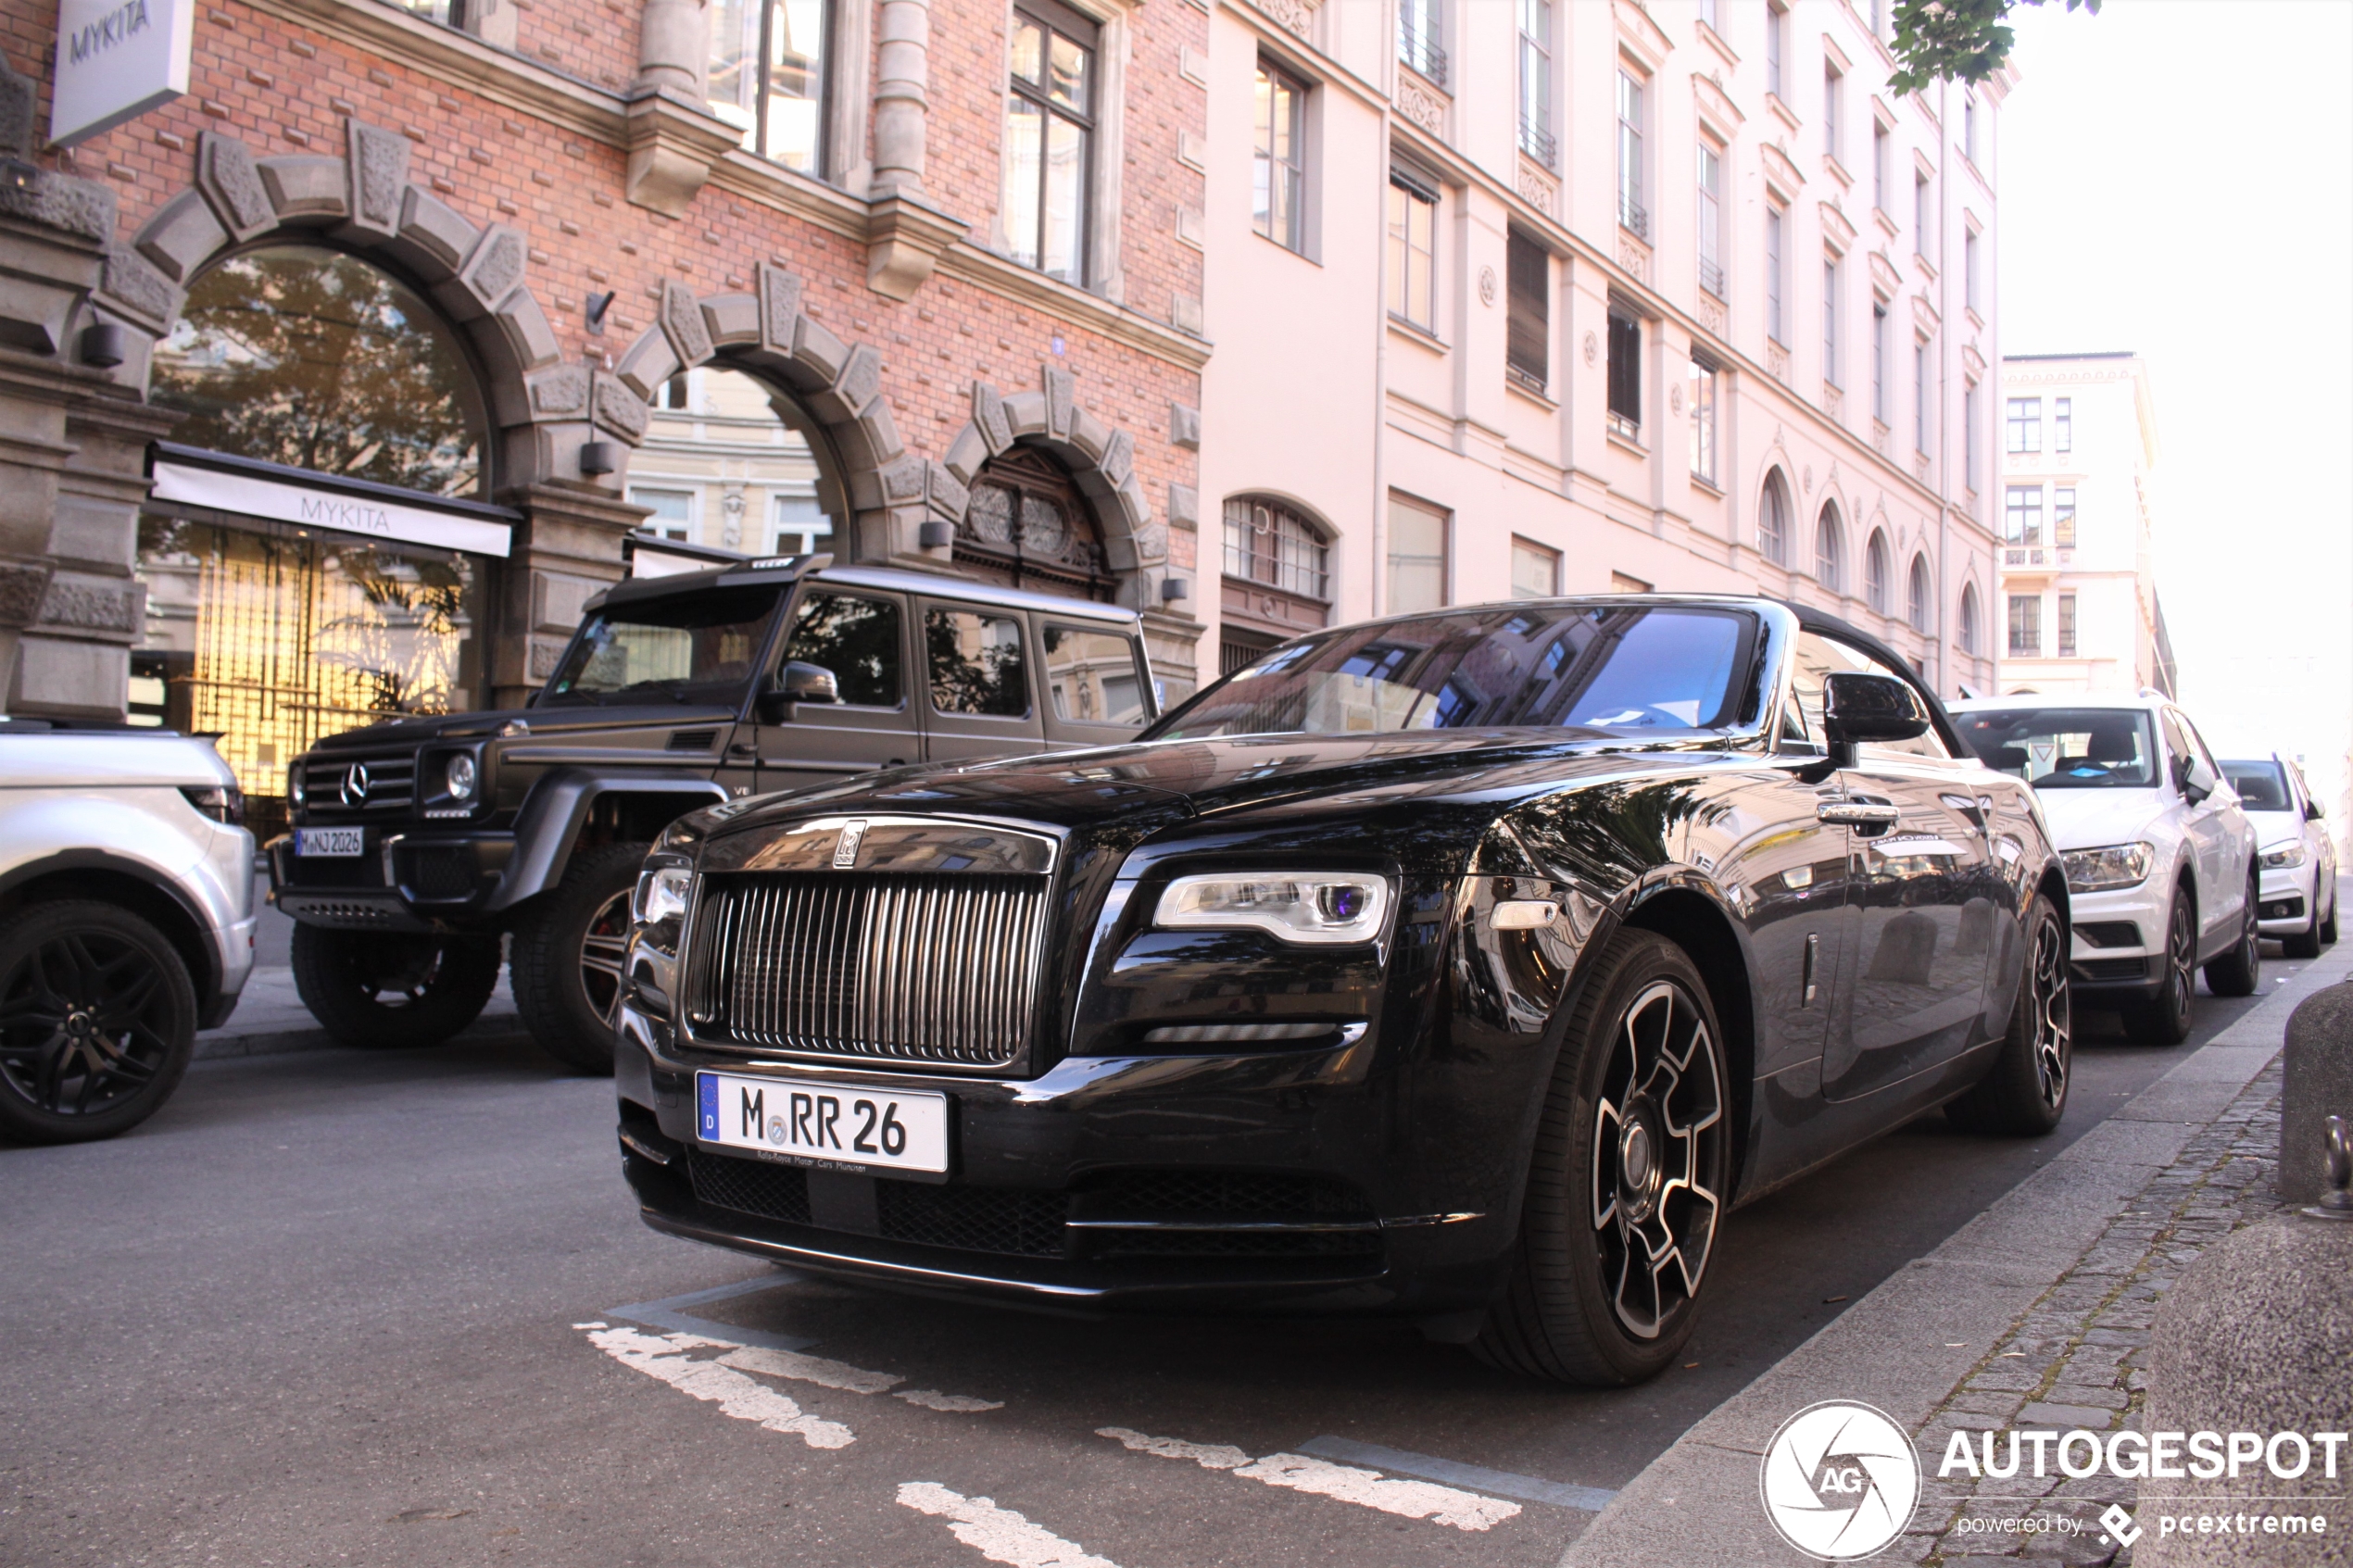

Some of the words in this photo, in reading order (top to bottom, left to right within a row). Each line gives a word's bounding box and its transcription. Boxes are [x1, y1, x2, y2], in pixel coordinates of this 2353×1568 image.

[69, 0, 150, 67] MYKITA
[301, 496, 390, 532] MYKITA
[332, 832, 359, 852] 2026
[706, 1115, 714, 1129] D
[742, 1085, 763, 1139] M
[790, 1092, 842, 1150] RR
[853, 1099, 906, 1157] 26
[757, 1149, 792, 1164] Rolls-Royce
[794, 1155, 814, 1166] Motor
[817, 1159, 833, 1169] Cars
